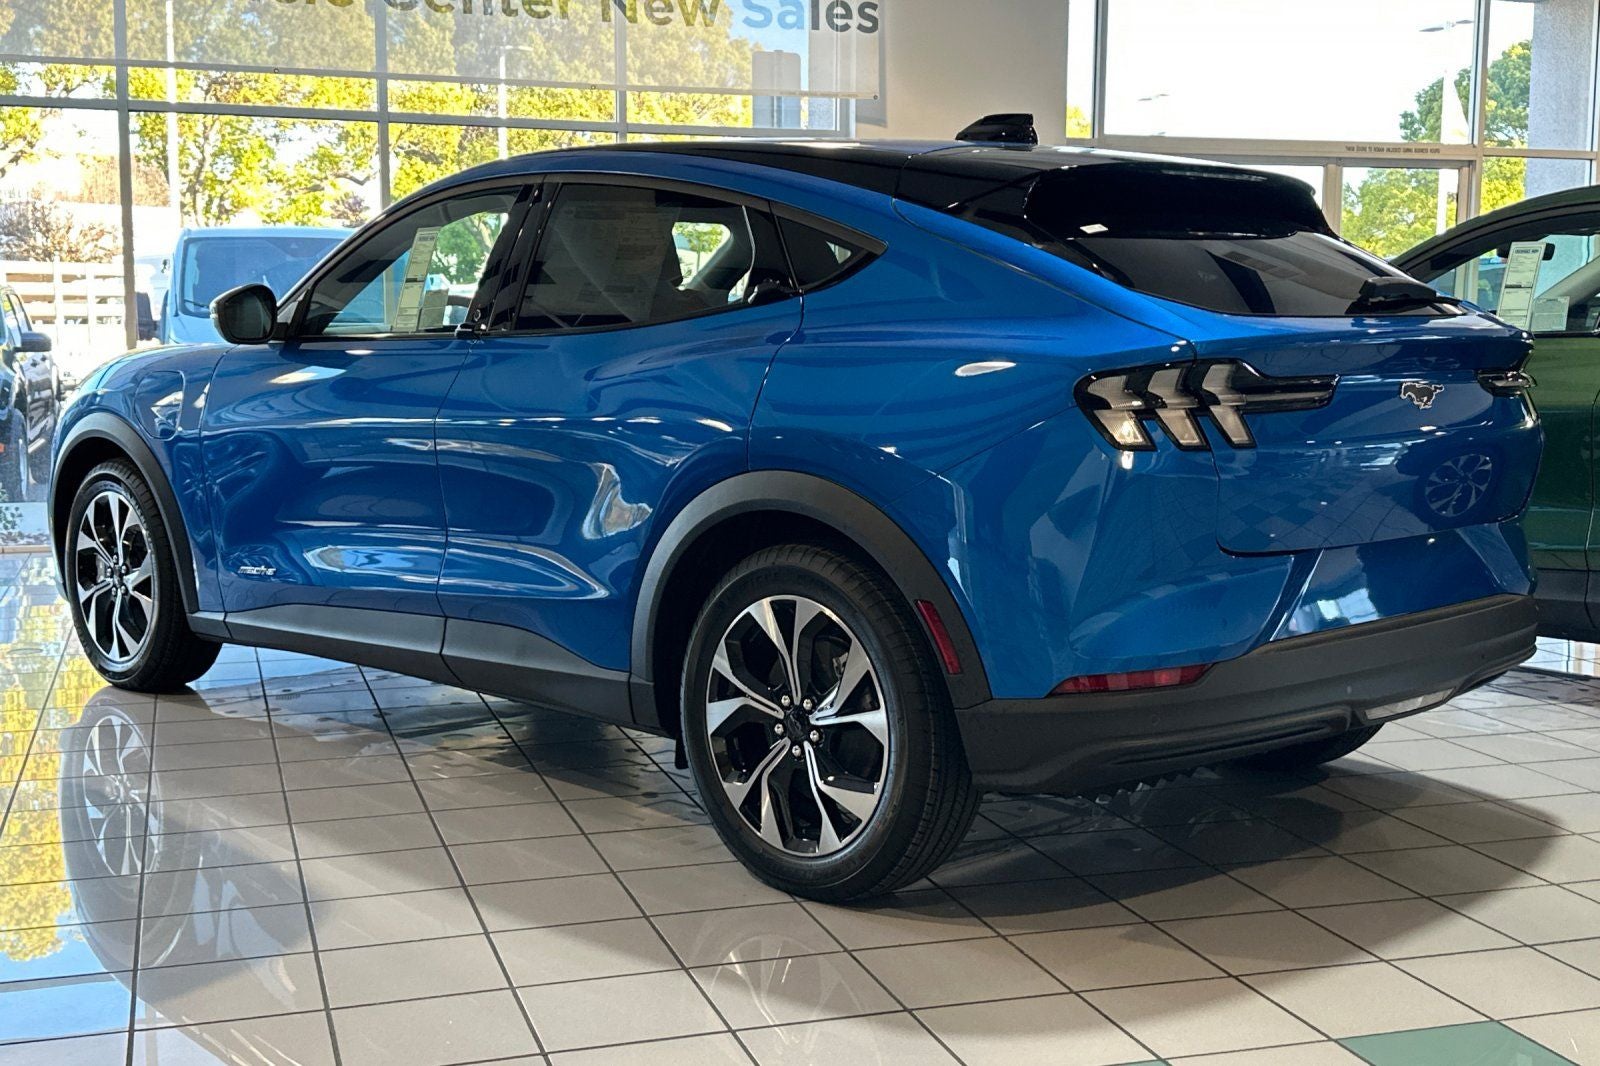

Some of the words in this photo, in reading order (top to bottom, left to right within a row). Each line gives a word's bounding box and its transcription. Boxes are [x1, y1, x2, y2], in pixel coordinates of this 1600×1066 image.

[384, 0, 569, 19] nter
[601, 0, 727, 27] New
[742, 0, 879, 34] Sales
